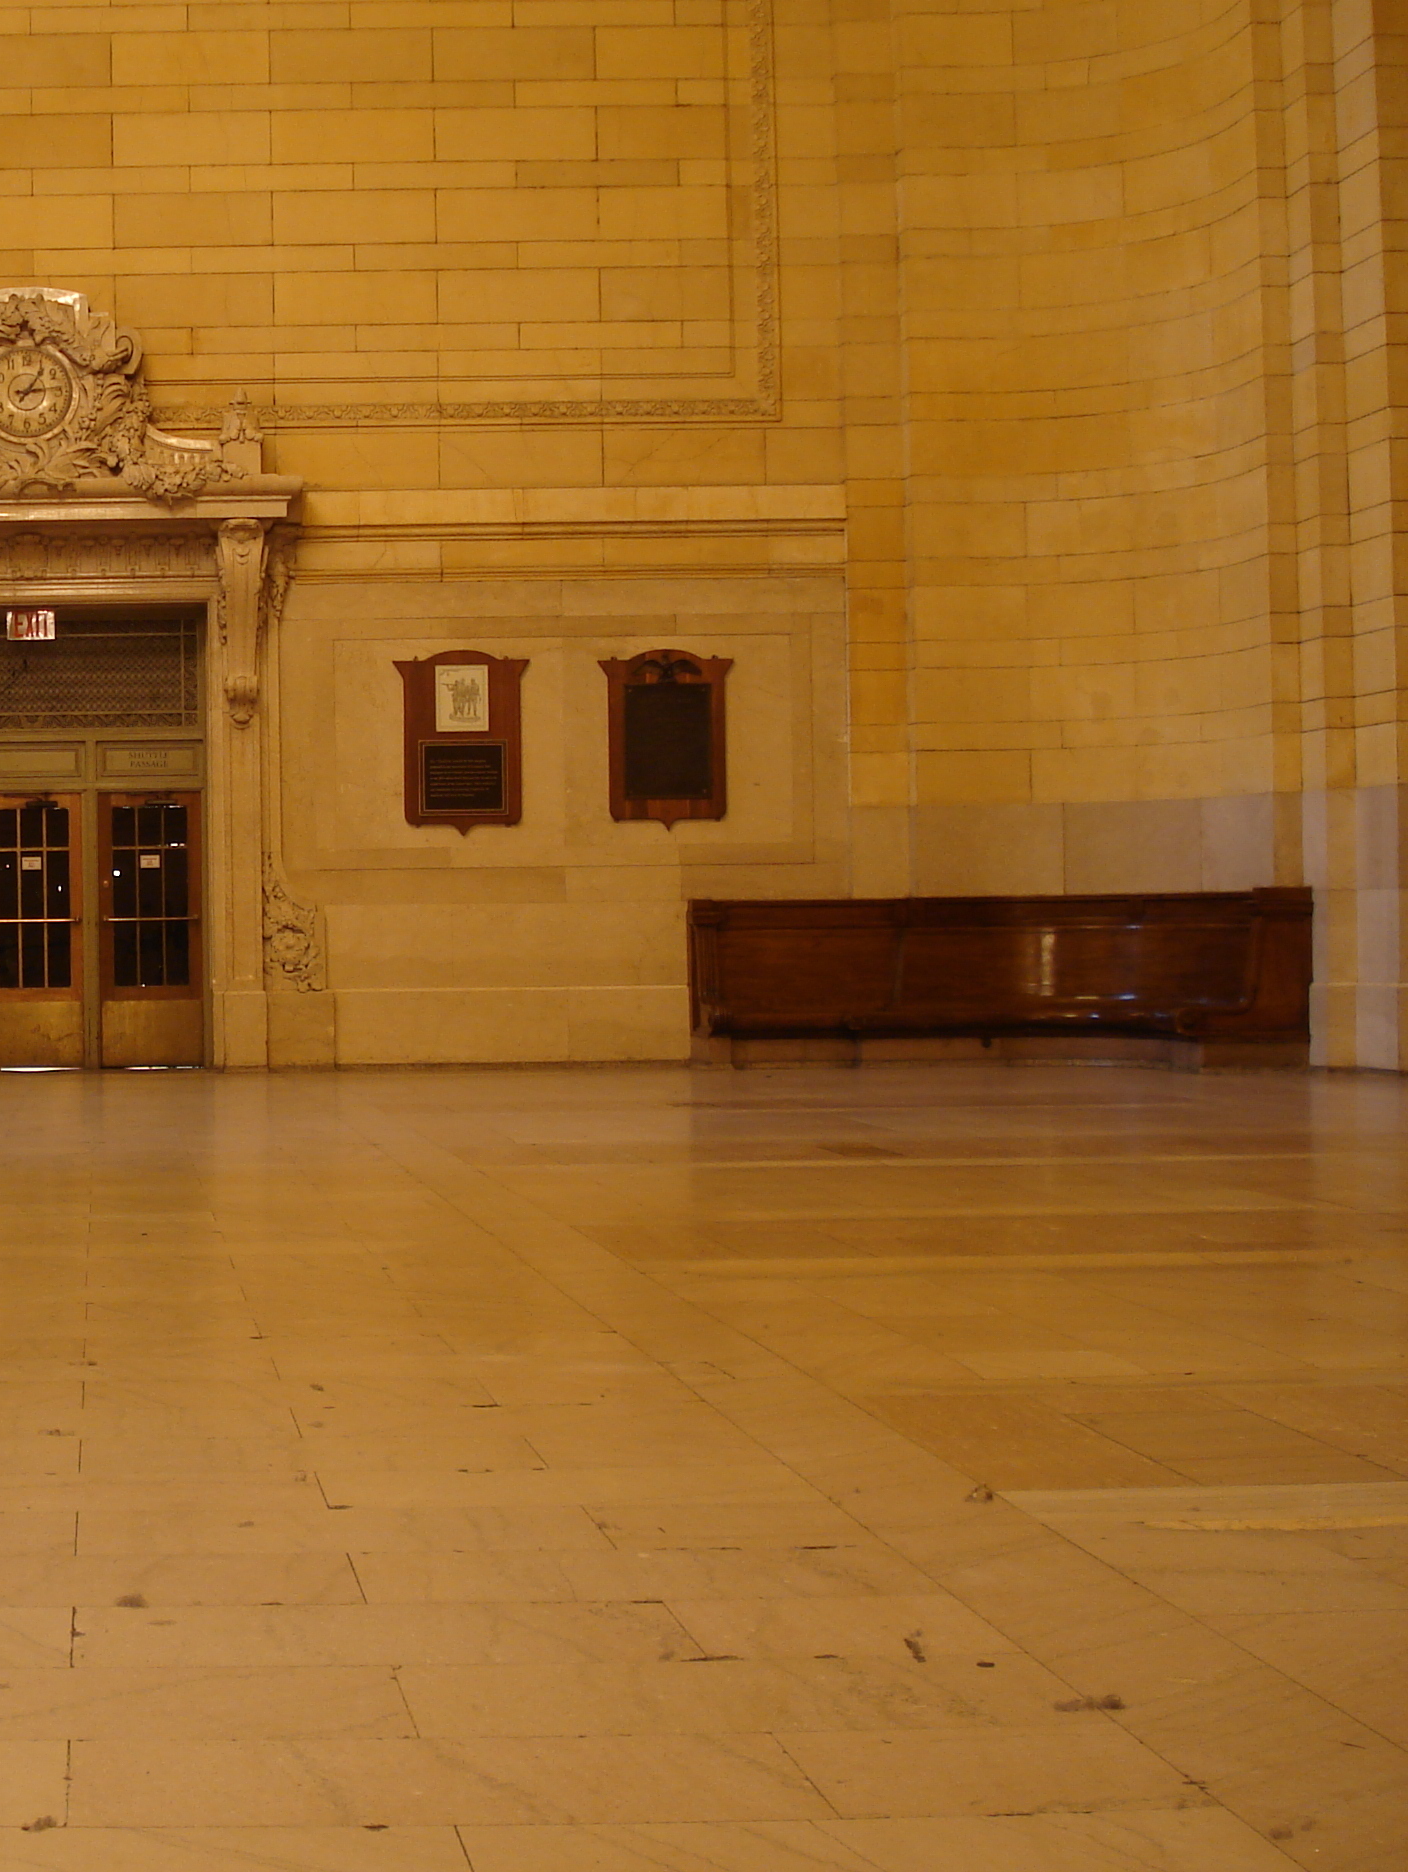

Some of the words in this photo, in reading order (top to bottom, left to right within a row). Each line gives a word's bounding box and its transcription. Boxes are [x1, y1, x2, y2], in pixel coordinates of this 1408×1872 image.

[6, 358, 14, 370] 11
[22, 354, 32, 366] 12
[49, 368, 57, 380] 2
[54, 386, 63, 397] 3
[48, 402, 57, 413] 4
[8, 415, 14, 425] 7
[23, 418, 31, 429] 6
[38, 413, 46, 425] 5
[14, 610, 50, 637] EXIT
